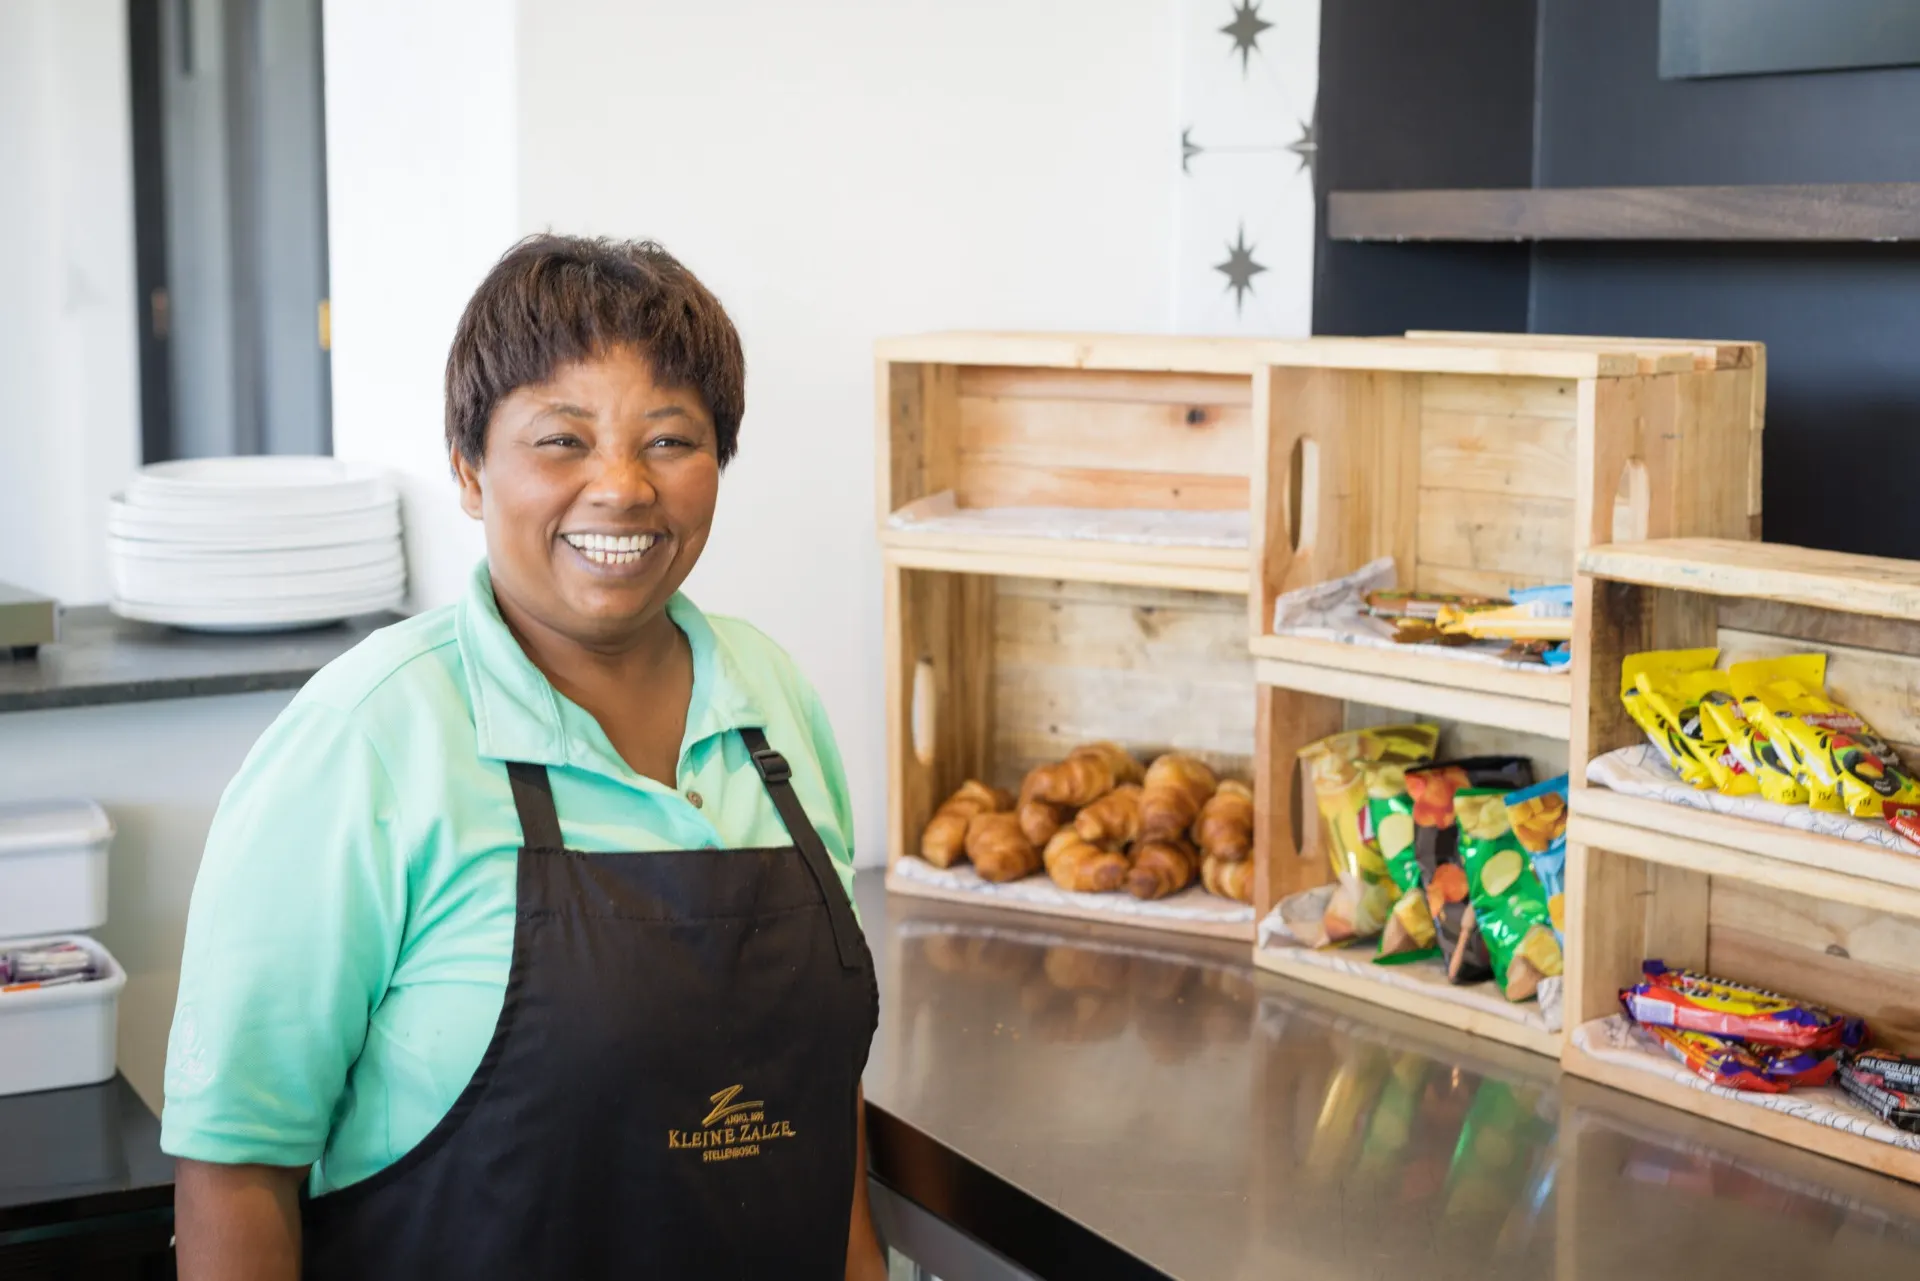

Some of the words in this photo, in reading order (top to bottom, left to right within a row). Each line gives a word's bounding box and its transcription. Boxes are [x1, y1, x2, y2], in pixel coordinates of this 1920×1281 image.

[1860, 1058, 1875, 1068] MILK
[1876, 1060, 1910, 1073] CHOCOLATE
[668, 1128, 735, 1149] KLEINE
[739, 1120, 796, 1143] ZALZE
[703, 1144, 760, 1162] STELLENBOSCH
